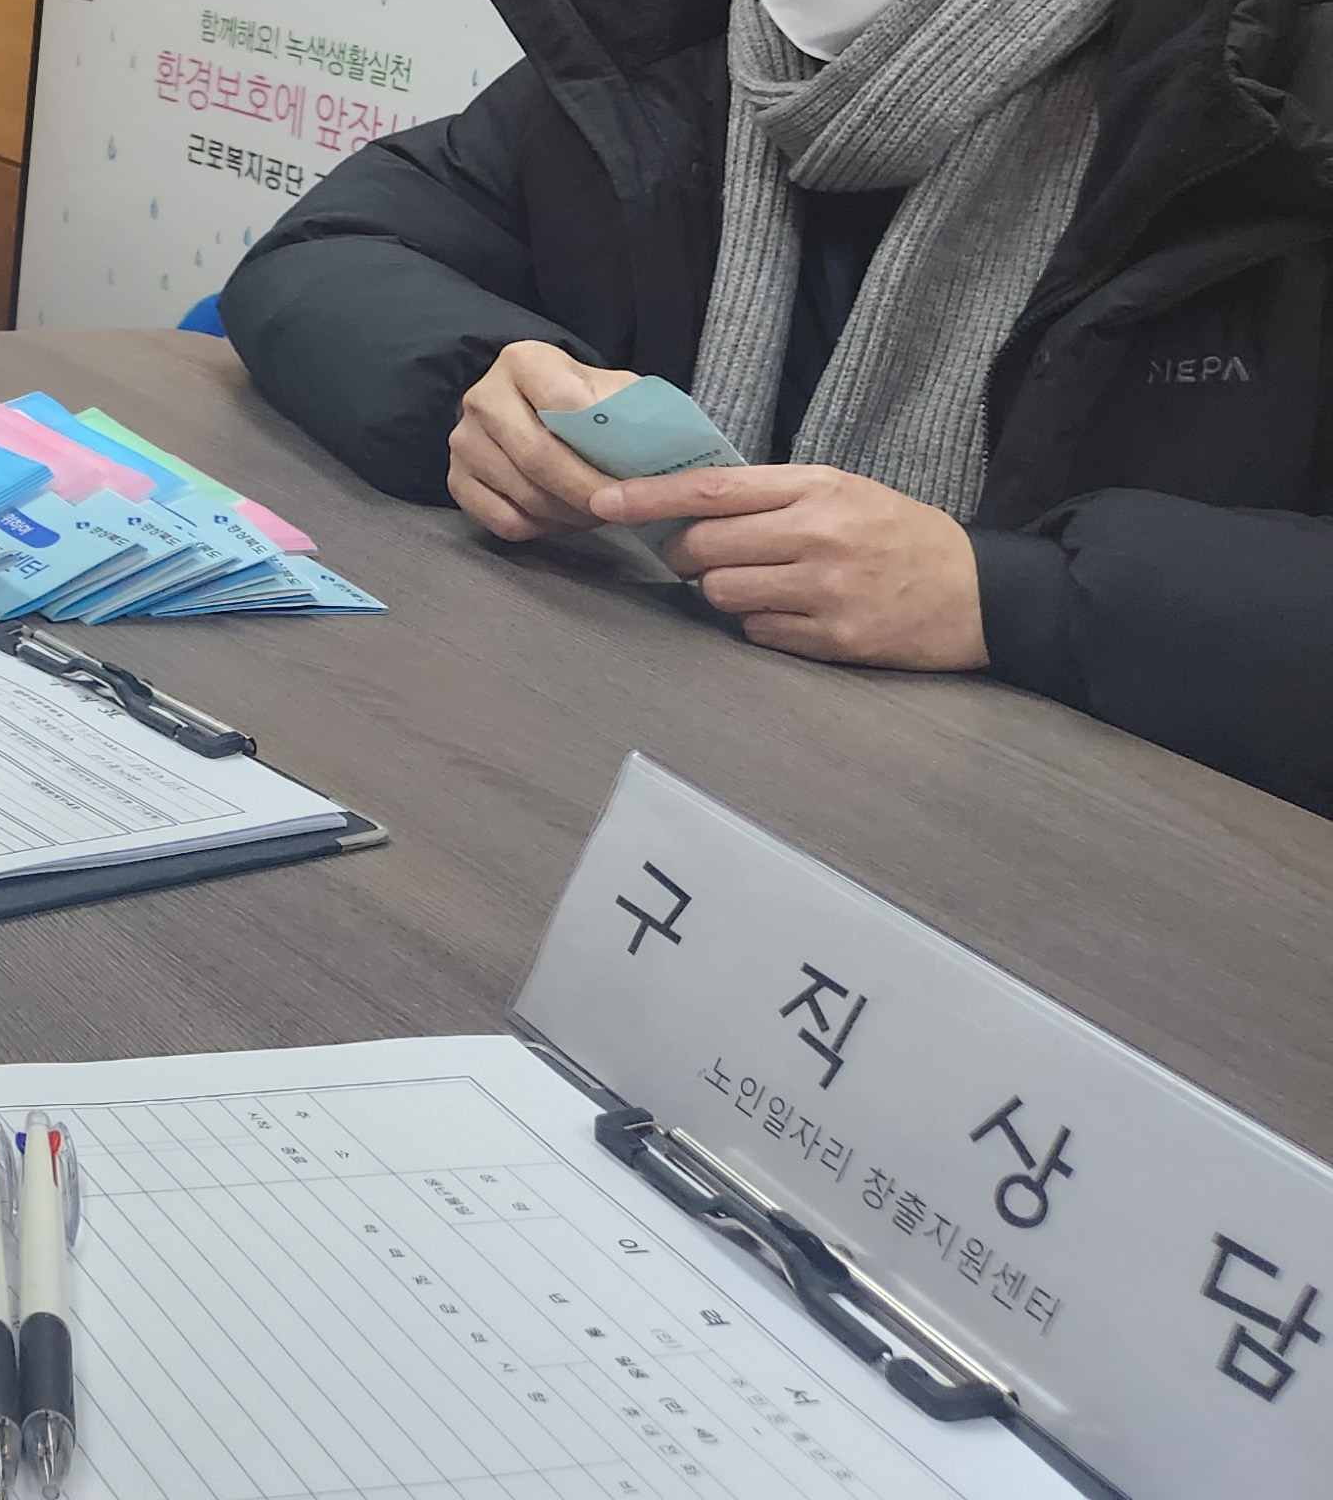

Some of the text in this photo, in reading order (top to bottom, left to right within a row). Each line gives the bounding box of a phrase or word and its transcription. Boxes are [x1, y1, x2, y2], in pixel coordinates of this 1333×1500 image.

[201, 9, 413, 93] 함께해요! 녹색생활실천
[154, 50, 307, 140] 환경보호에
[187, 133, 304, 198] 근로복지공단
[1147, 355, 1250, 385] NEPA
[89, 524, 131, 549] 경상북도
[140, 520, 182, 547] 경상북도
[227, 521, 271, 556] 경상북도
[614, 859, 1331, 1404] 구 직 상 담
[423, 1177, 475, 1216] 생년월일
[703, 1056, 1063, 1338] 노인일자리 창출지원센터
